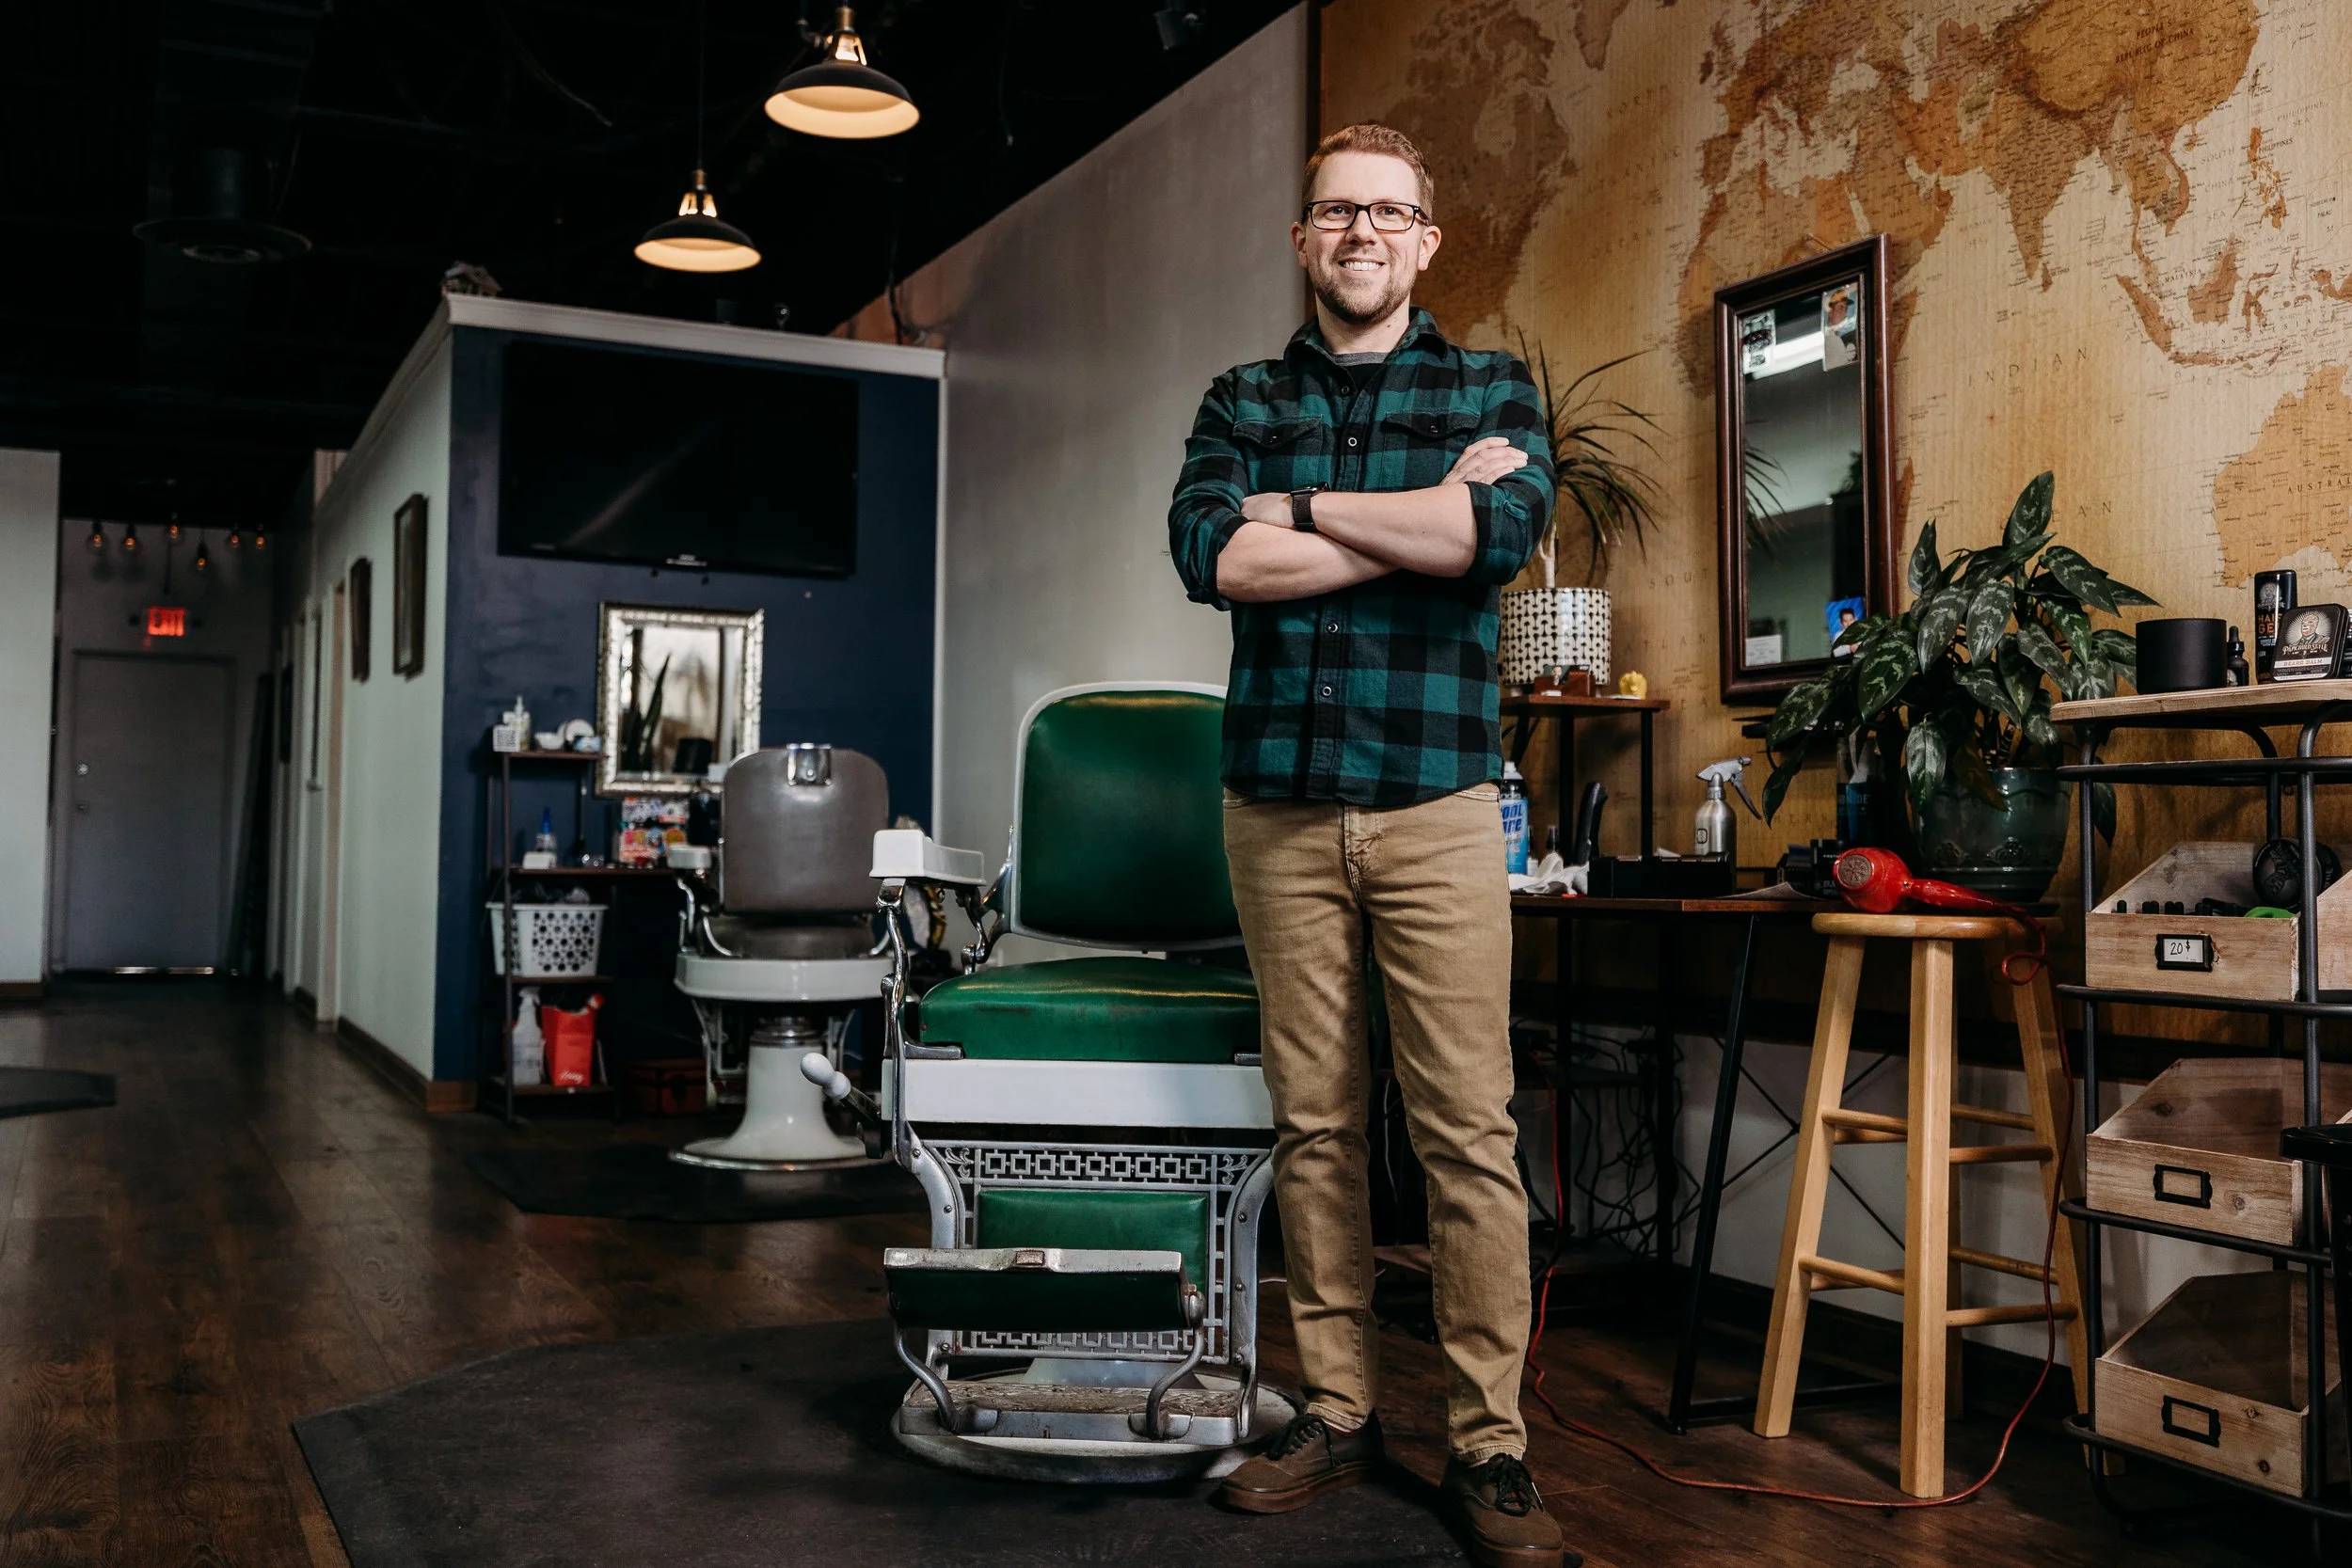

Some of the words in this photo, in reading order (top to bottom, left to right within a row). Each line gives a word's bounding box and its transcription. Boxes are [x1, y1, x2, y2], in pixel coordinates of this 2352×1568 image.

[2154, 38, 2166, 49] OF
[2168, 27, 2194, 43] CHINA
[2258, 137, 2294, 154] PHILIPPINES
[2201, 147, 2235, 165] SOUTH
[2165, 268, 2202, 282] MALAYSIA
[1968, 346, 2088, 388] INDIAN
[1649, 568, 1708, 590] SOUT
[1627, 632, 1708, 654] ATLAN
[1502, 818, 1522, 834] are
